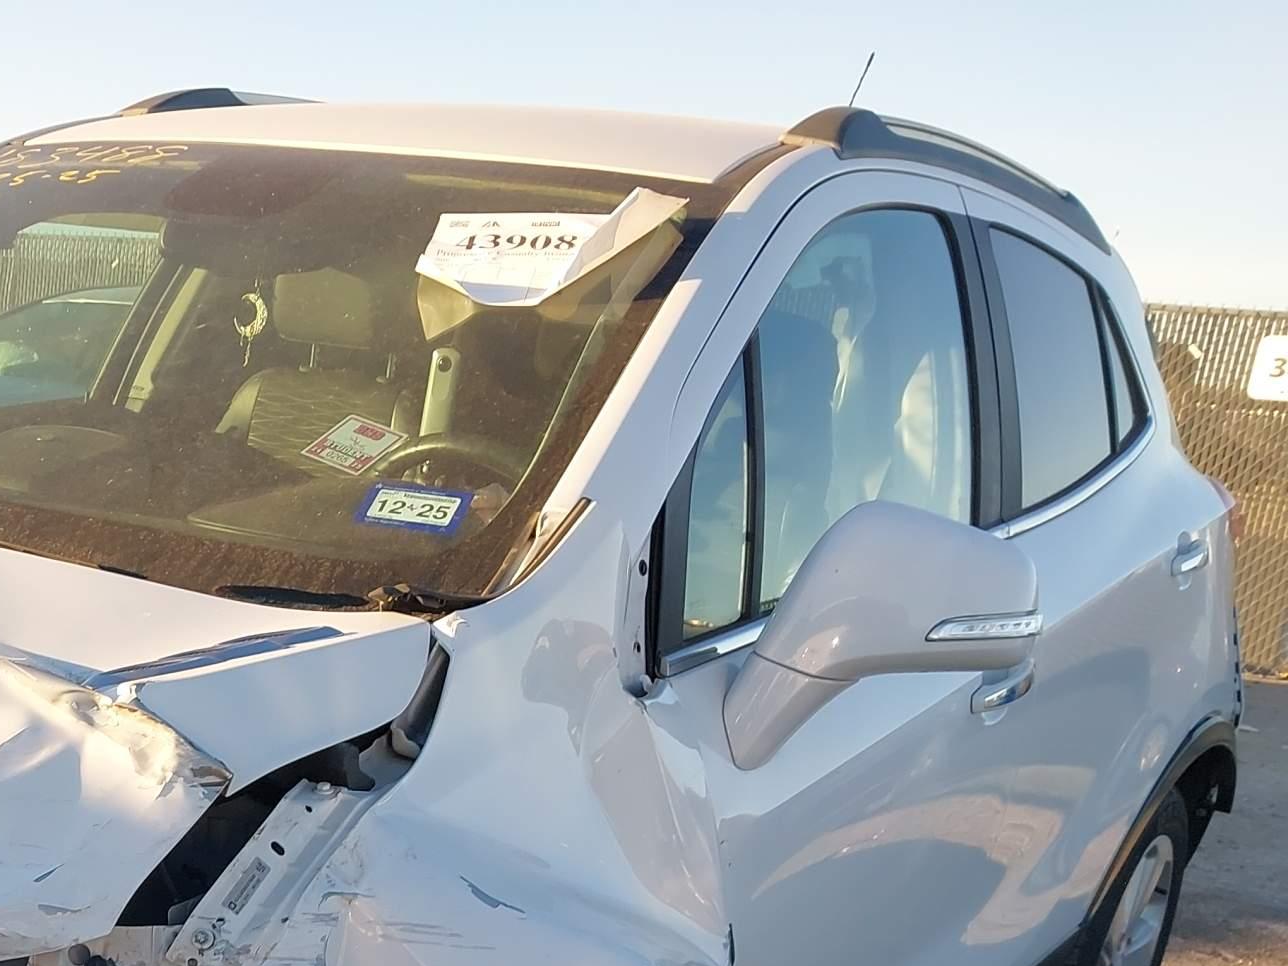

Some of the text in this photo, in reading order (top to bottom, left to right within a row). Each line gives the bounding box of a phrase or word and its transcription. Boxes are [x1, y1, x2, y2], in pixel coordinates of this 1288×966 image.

[455, 233, 578, 250] 43908
[377, 499, 451, 520] 12 25
